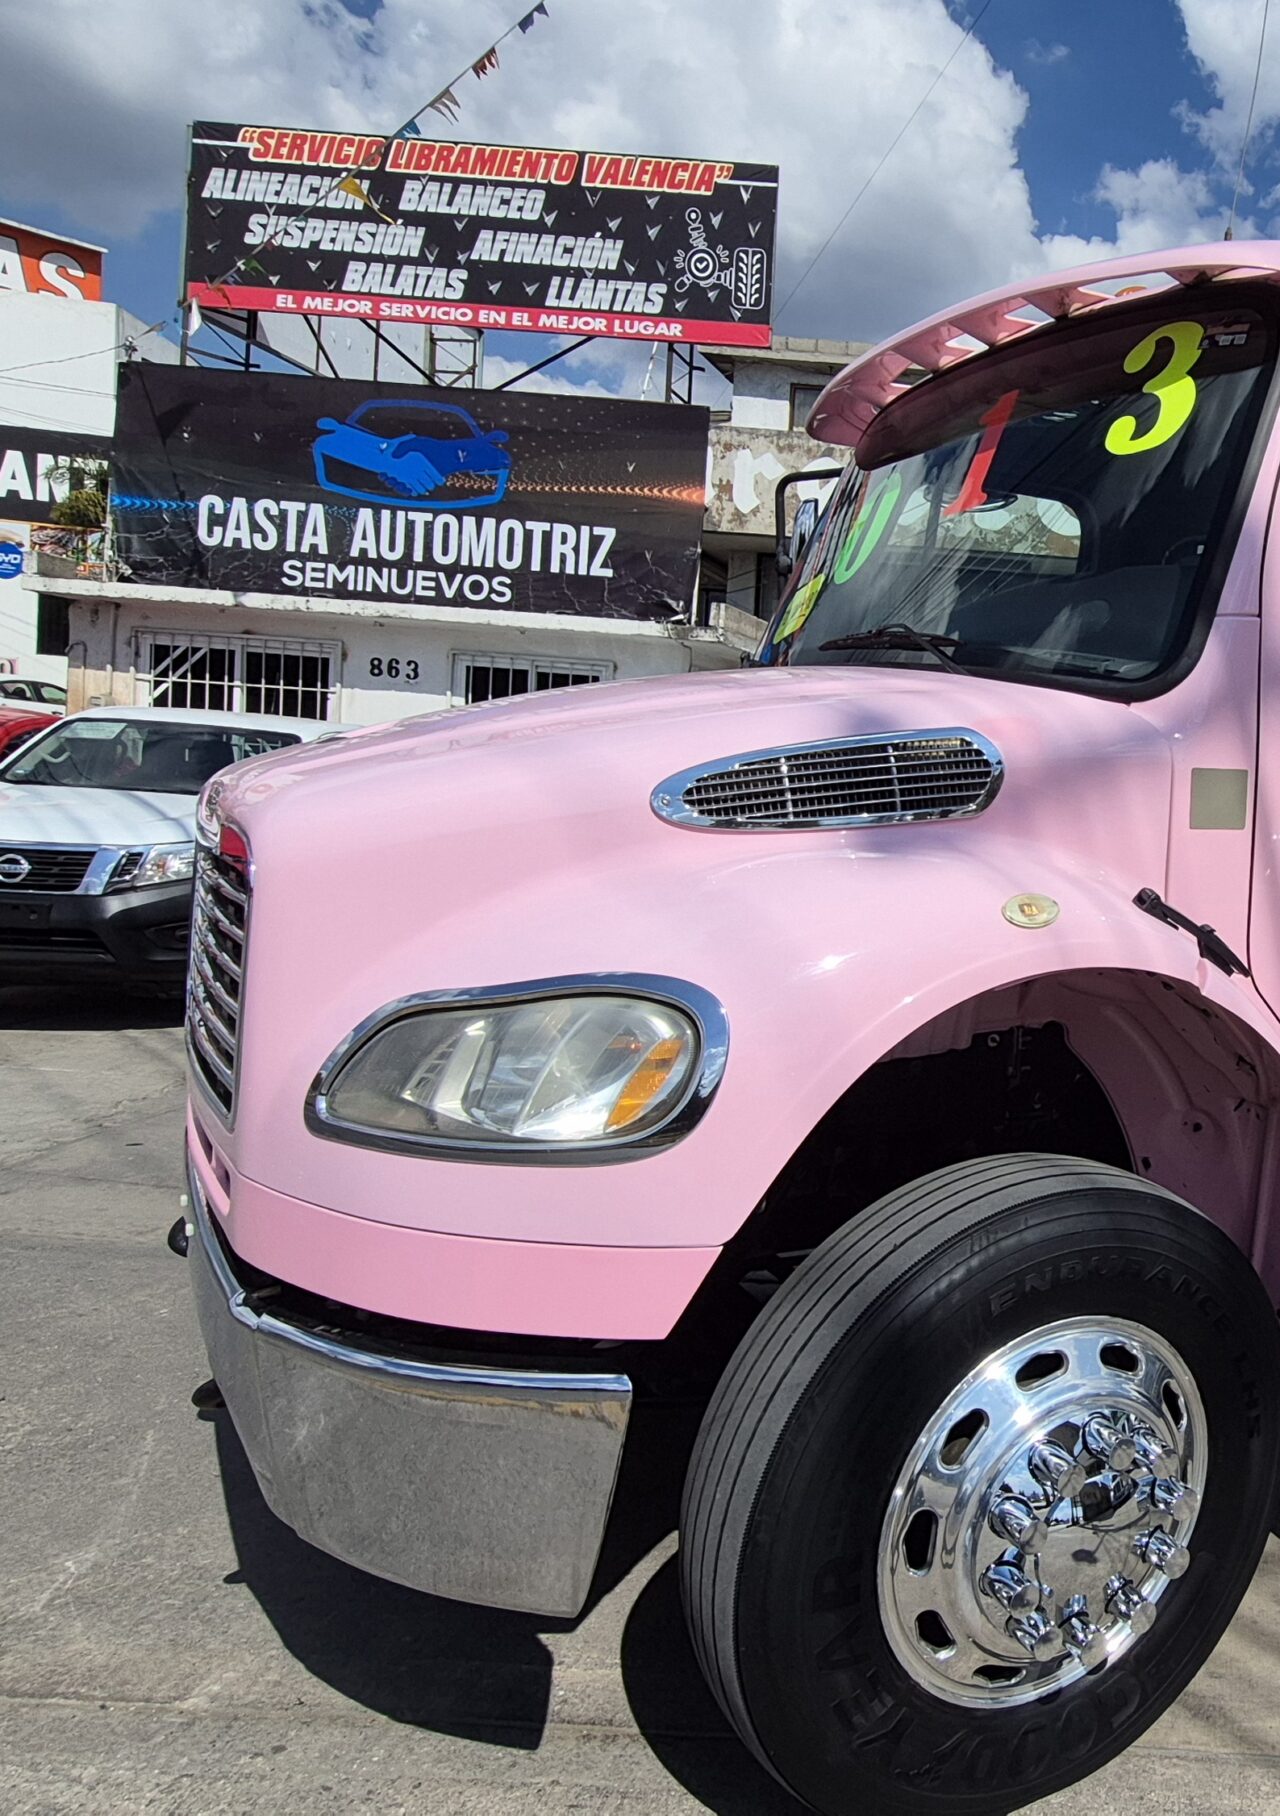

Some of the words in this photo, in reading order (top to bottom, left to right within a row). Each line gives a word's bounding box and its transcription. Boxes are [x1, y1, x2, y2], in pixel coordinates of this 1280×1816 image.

[387, 139, 578, 185] LIBRAMIENTO
[201, 168, 371, 211] ALINEACIÓN
[399, 179, 547, 221] BALANCEO
[243, 213, 426, 257] SUSPENSIÓN
[470, 230, 624, 270] AFINACIÓN
[342, 260, 469, 300] BALATAS
[545, 275, 668, 315] LLANTAS
[275, 294, 297, 309] EL
[302, 298, 373, 315] MEJOR
[379, 302, 473, 323] SERVICIO
[479, 309, 506, 324] EN
[511, 312, 533, 327] EL
[538, 315, 608, 332] MEJOR
[613, 319, 683, 338] LUGAR
[1104, 320, 1206, 456] 3
[197, 494, 329, 556] CASTA
[350, 507, 617, 579] AUTOMOTRIZ
[280, 559, 513, 604] SEMINUEVOS
[368, 656, 421, 681] 863
[986, 1253, 1236, 1337] ENDURANCE
